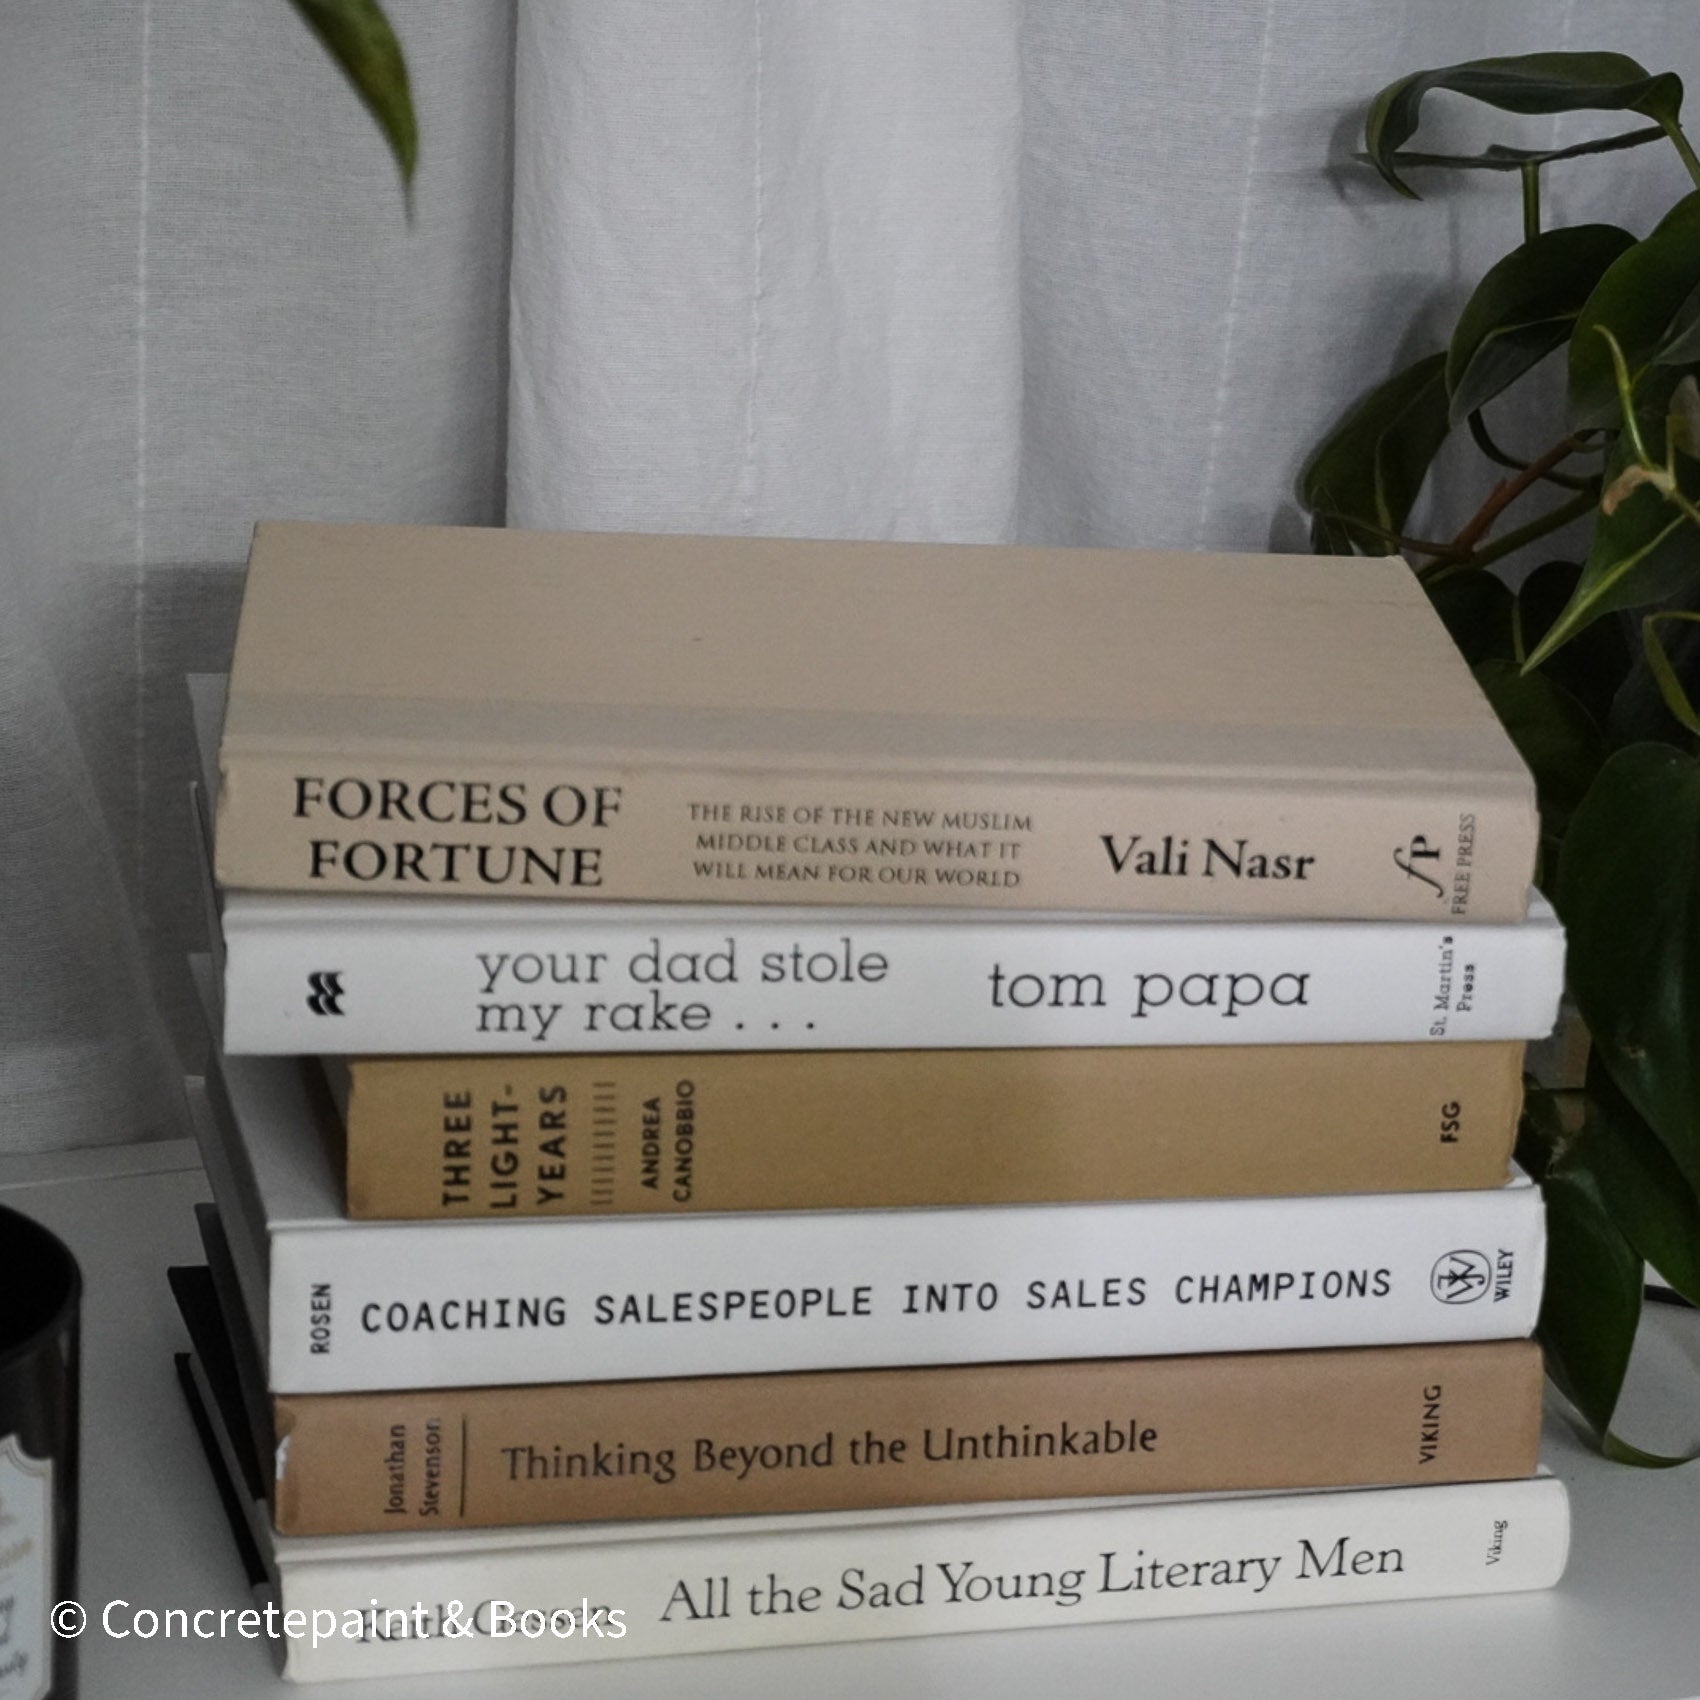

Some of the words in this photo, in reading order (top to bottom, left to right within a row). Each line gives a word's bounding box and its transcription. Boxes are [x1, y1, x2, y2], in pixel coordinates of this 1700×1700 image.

[294, 776, 527, 826] FORCES
[542, 785, 622, 827] OF
[687, 801, 732, 823] THE
[739, 803, 787, 824] RISE
[792, 805, 824, 825] OF
[831, 806, 875, 827] THE
[882, 809, 936, 828] NEW
[941, 811, 1033, 832] MUSLIM
[310, 839, 603, 887] FORTUNE
[695, 832, 787, 853] MIDDLE
[792, 834, 859, 855] CLASS
[864, 838, 918, 857] AND
[922, 839, 993, 859] WHAT
[999, 841, 1022, 860] IT
[1100, 834, 1189, 877] Vali
[1203, 838, 1316, 881] Nasr
[1455, 812, 1477, 867] PRESS
[692, 860, 747, 880] WILL
[754, 863, 820, 881] MEAN
[828, 863, 874, 884] FOR
[877, 866, 928, 886] OUR
[934, 867, 1021, 888] WORLD
[1450, 872, 1473, 915] FREE
[476, 953, 608, 993] your
[628, 937, 739, 984] dad
[760, 936, 890, 984] stole
[988, 963, 1107, 1009] tom
[1131, 972, 1311, 1019] papa
[1433, 935, 1454, 1012] Martin's
[1455, 963, 1476, 1012] Press
[476, 1002, 563, 1042] my
[585, 988, 712, 1032] rake
[1429, 1015, 1448, 1036] St.
[441, 1091, 473, 1208] THREE
[489, 1084, 520, 1210] LIGHT-
[536, 1085, 568, 1206] YEARS
[640, 1096, 662, 1190] ANDREA
[672, 1079, 696, 1203] CANOBBIO
[1439, 1100, 1462, 1144] FSG
[361, 1296, 566, 1334] COACHING
[594, 1285, 873, 1326] SALESPEOPLE
[902, 1281, 999, 1315] INTO
[1026, 1276, 1147, 1310] SALES
[1175, 1268, 1391, 1305] CHAMPIONS
[1493, 1248, 1514, 1303] WILEY
[309, 1283, 332, 1355] ROSEN
[500, 1440, 677, 1485] Thinking
[694, 1431, 834, 1481] Beyond
[849, 1429, 908, 1466] the
[923, 1418, 1158, 1462] Unthinkable
[1418, 1384, 1442, 1465] VIKING
[383, 1423, 409, 1515] Jonathan
[418, 1415, 443, 1518] Stevenson
[1485, 1519, 1509, 1566] Viking
[659, 1575, 731, 1622] All
[749, 1572, 822, 1617] the
[836, 1563, 925, 1611] Sad
[936, 1561, 1087, 1607] Young
[1097, 1549, 1282, 1594] Literary
[1295, 1536, 1404, 1580] Men
